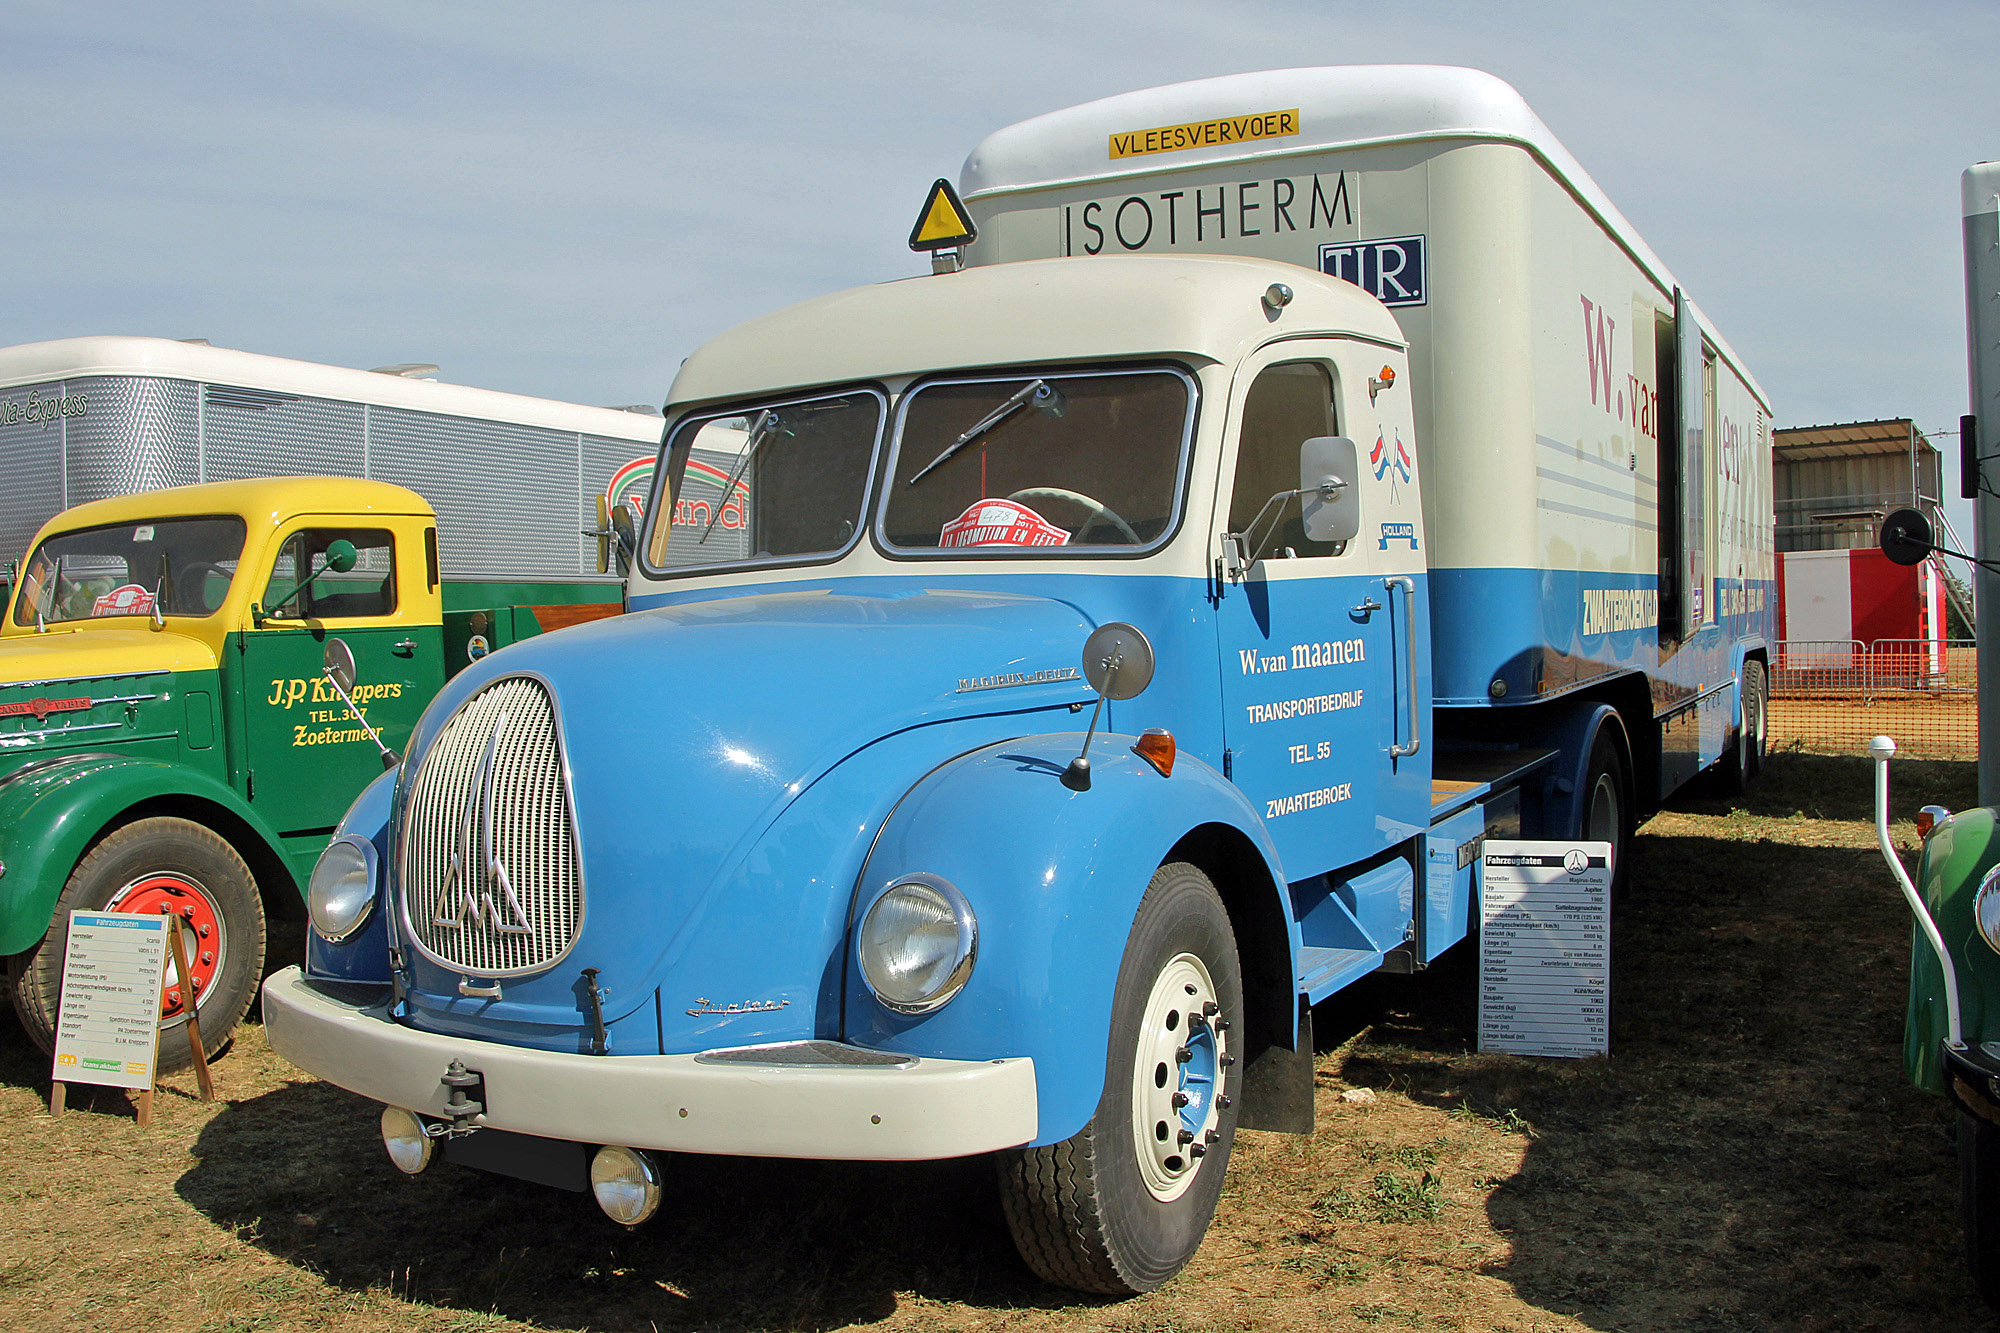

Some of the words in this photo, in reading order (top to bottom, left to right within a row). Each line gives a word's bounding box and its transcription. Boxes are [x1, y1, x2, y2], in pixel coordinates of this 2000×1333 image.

[1114, 113, 1294, 156] VLEESVERVOER
[1066, 169, 1352, 257] ISOTHERM
[983, 510, 1011, 522] 478
[1016, 520, 1034, 529] 2011
[955, 527, 1009, 547] LOCOMOTION
[1012, 529, 1028, 542] EN
[1382, 525, 1412, 536] HOLLAND
[1291, 638, 1365, 670] maanen
[55, 699, 87, 709] VABIS
[1246, 689, 1364, 724] TRANSPORTBEDRIJF
[292, 725, 384, 747] Zoetermeer
[1288, 744, 1314, 764] TEL.
[1317, 741, 1331, 759] 55
[1266, 782, 1352, 819] ZWARTEBROEK
[1486, 856, 1542, 866] Fahrzeugdaten
[96, 919, 139, 928] Fahrzeugdaten
